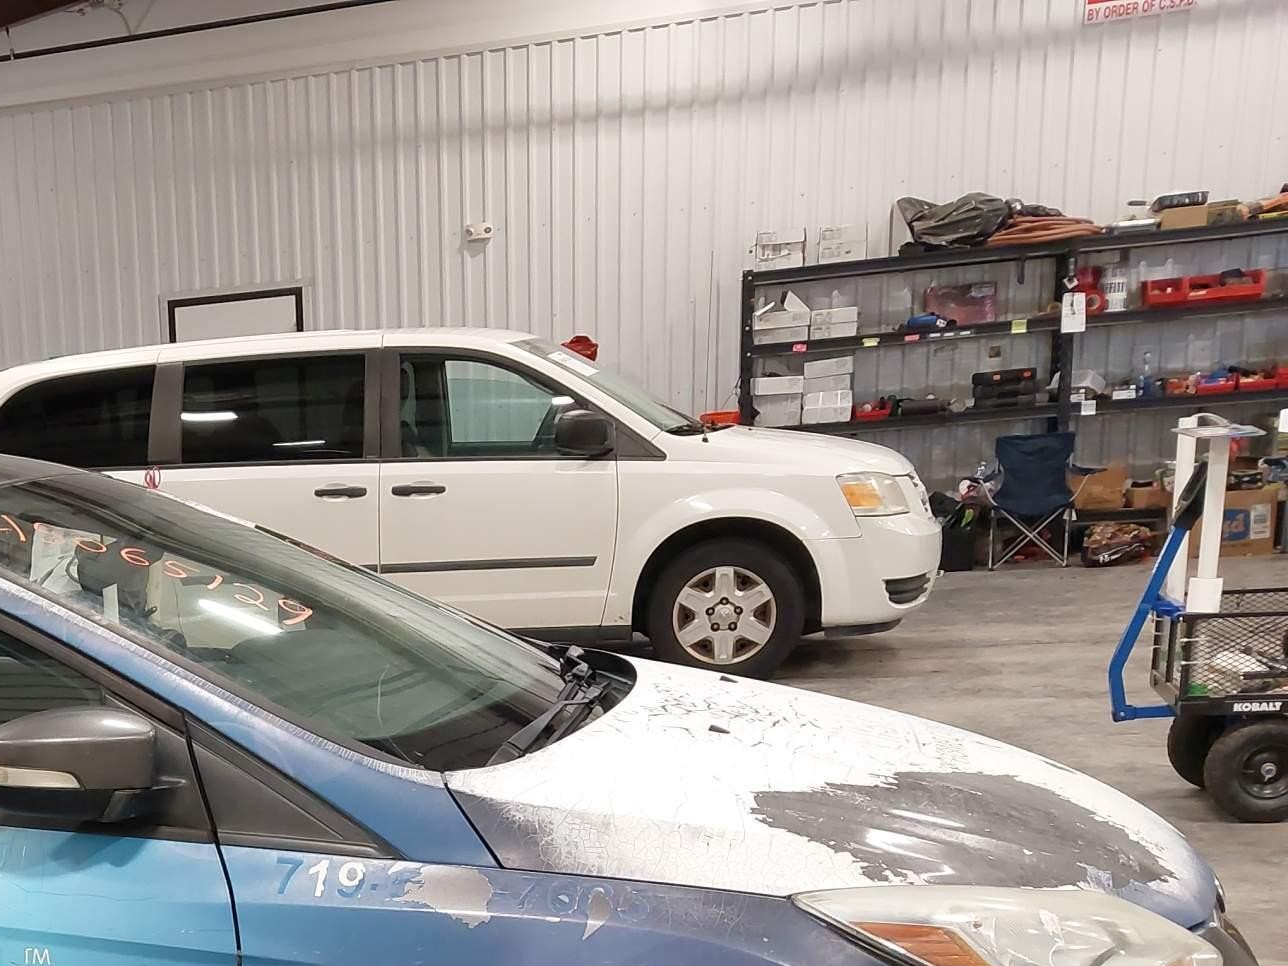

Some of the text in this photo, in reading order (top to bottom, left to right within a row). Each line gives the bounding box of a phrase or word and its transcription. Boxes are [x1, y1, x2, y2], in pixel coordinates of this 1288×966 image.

[1087, 8, 1102, 21] BY
[1103, 2, 1139, 18] ORDER
[1142, 0, 1157, 13] OF
[1233, 701, 1283, 712] KOBALT
